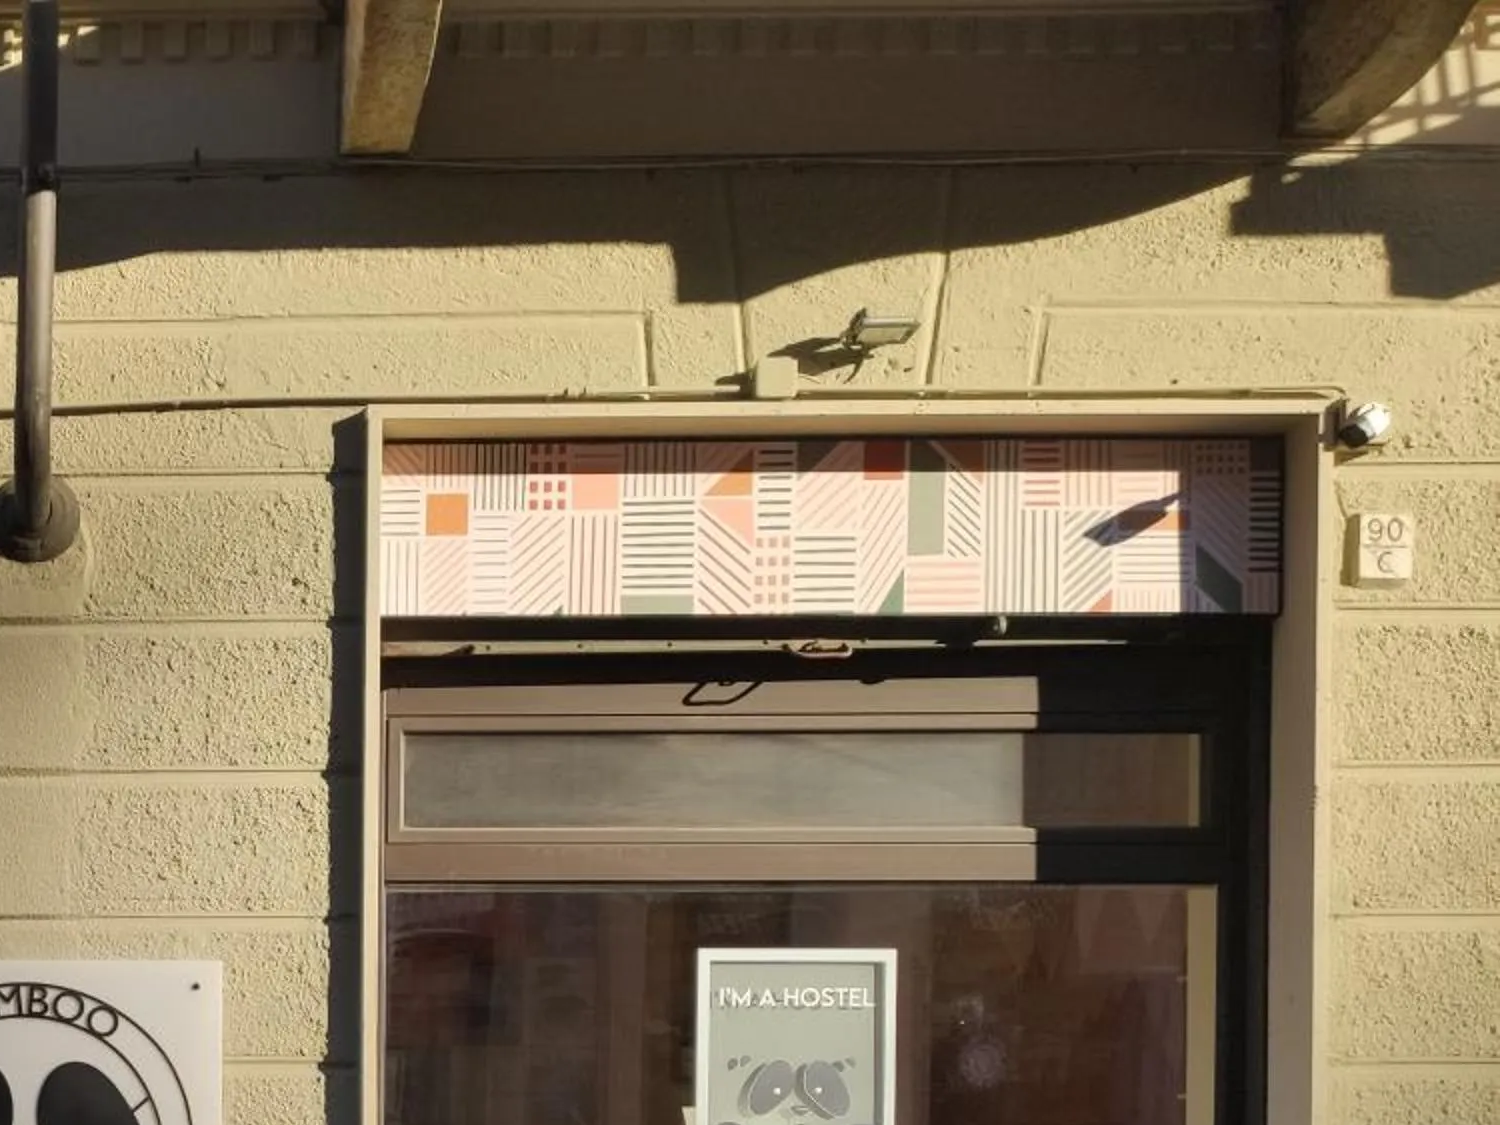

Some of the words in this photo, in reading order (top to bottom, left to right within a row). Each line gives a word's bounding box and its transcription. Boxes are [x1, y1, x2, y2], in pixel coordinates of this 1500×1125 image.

[1367, 517, 1403, 542] 90
[1377, 551, 1395, 573] C
[719, 986, 751, 1008] I'M
[759, 987, 776, 1007] A
[783, 986, 876, 1008] HOSTEL
